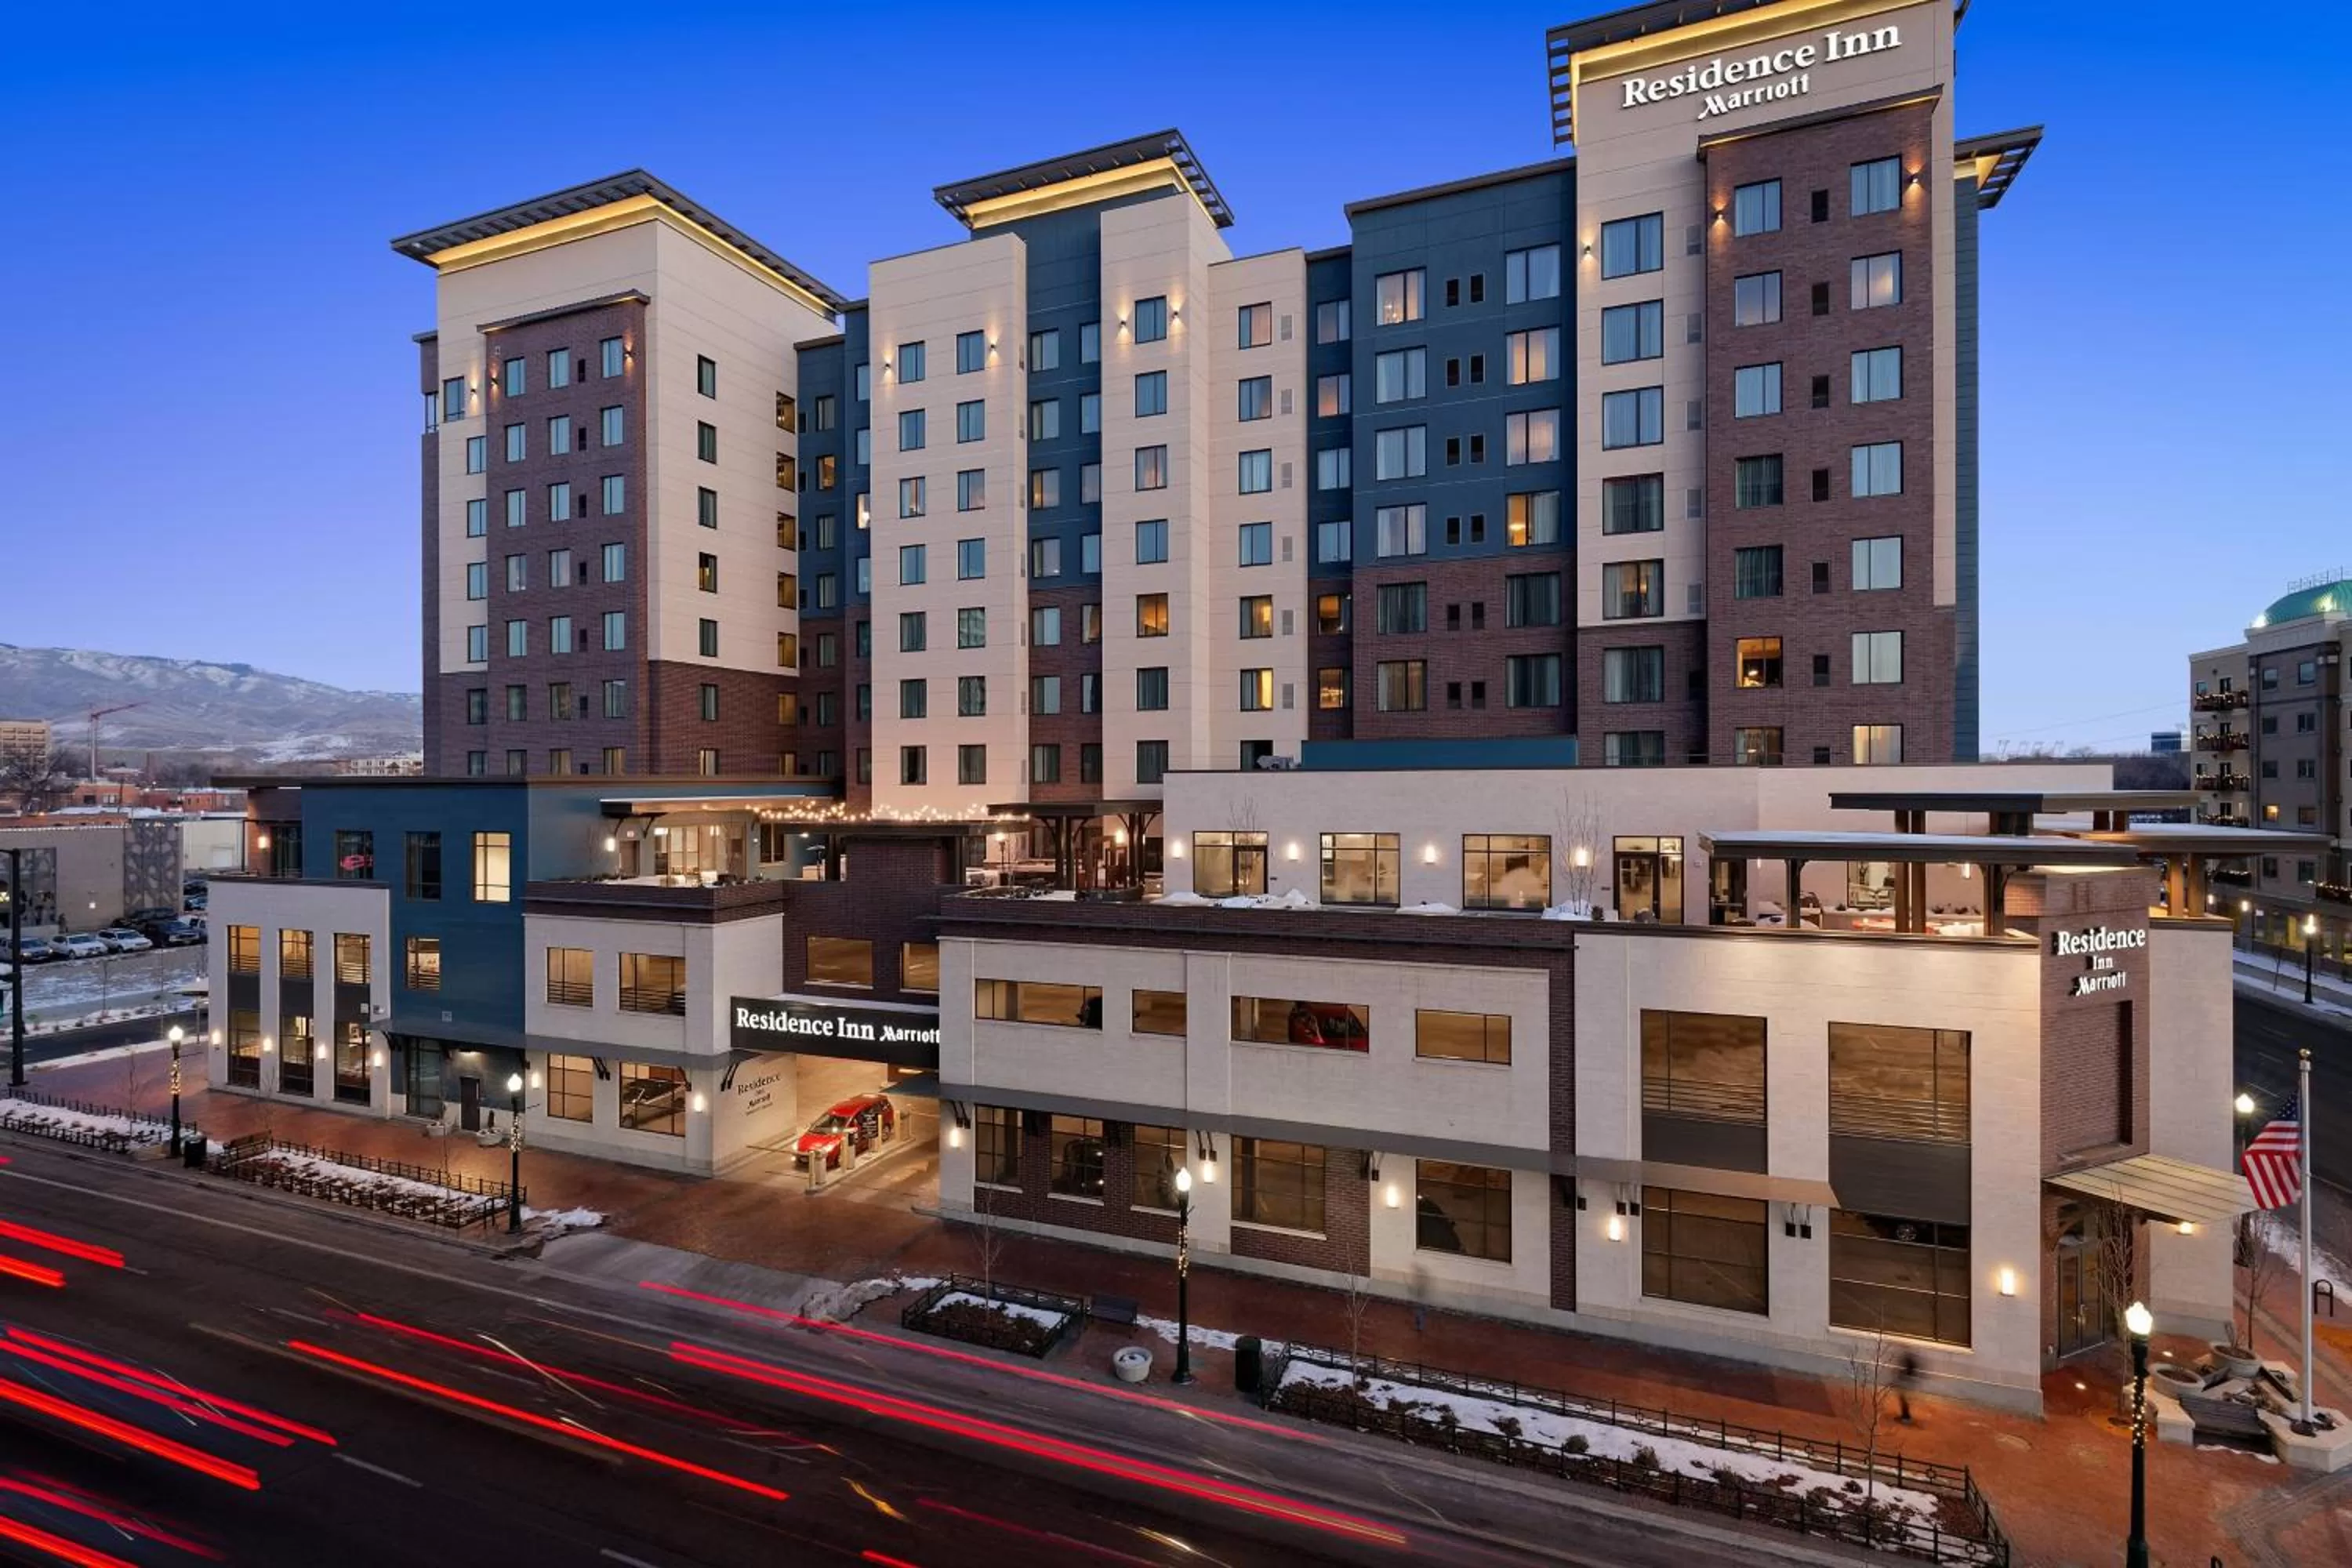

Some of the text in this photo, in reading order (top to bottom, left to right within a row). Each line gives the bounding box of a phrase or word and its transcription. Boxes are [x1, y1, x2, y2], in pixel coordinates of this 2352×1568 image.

[1622, 24, 1902, 108] Residence Inn
[1698, 73, 1809, 121] Marriott
[2057, 926, 2146, 956] Residence
[2092, 955, 2114, 971] Inn
[2075, 971, 2126, 996] Marriott
[737, 1007, 940, 1044] Residence Inn Marriott
